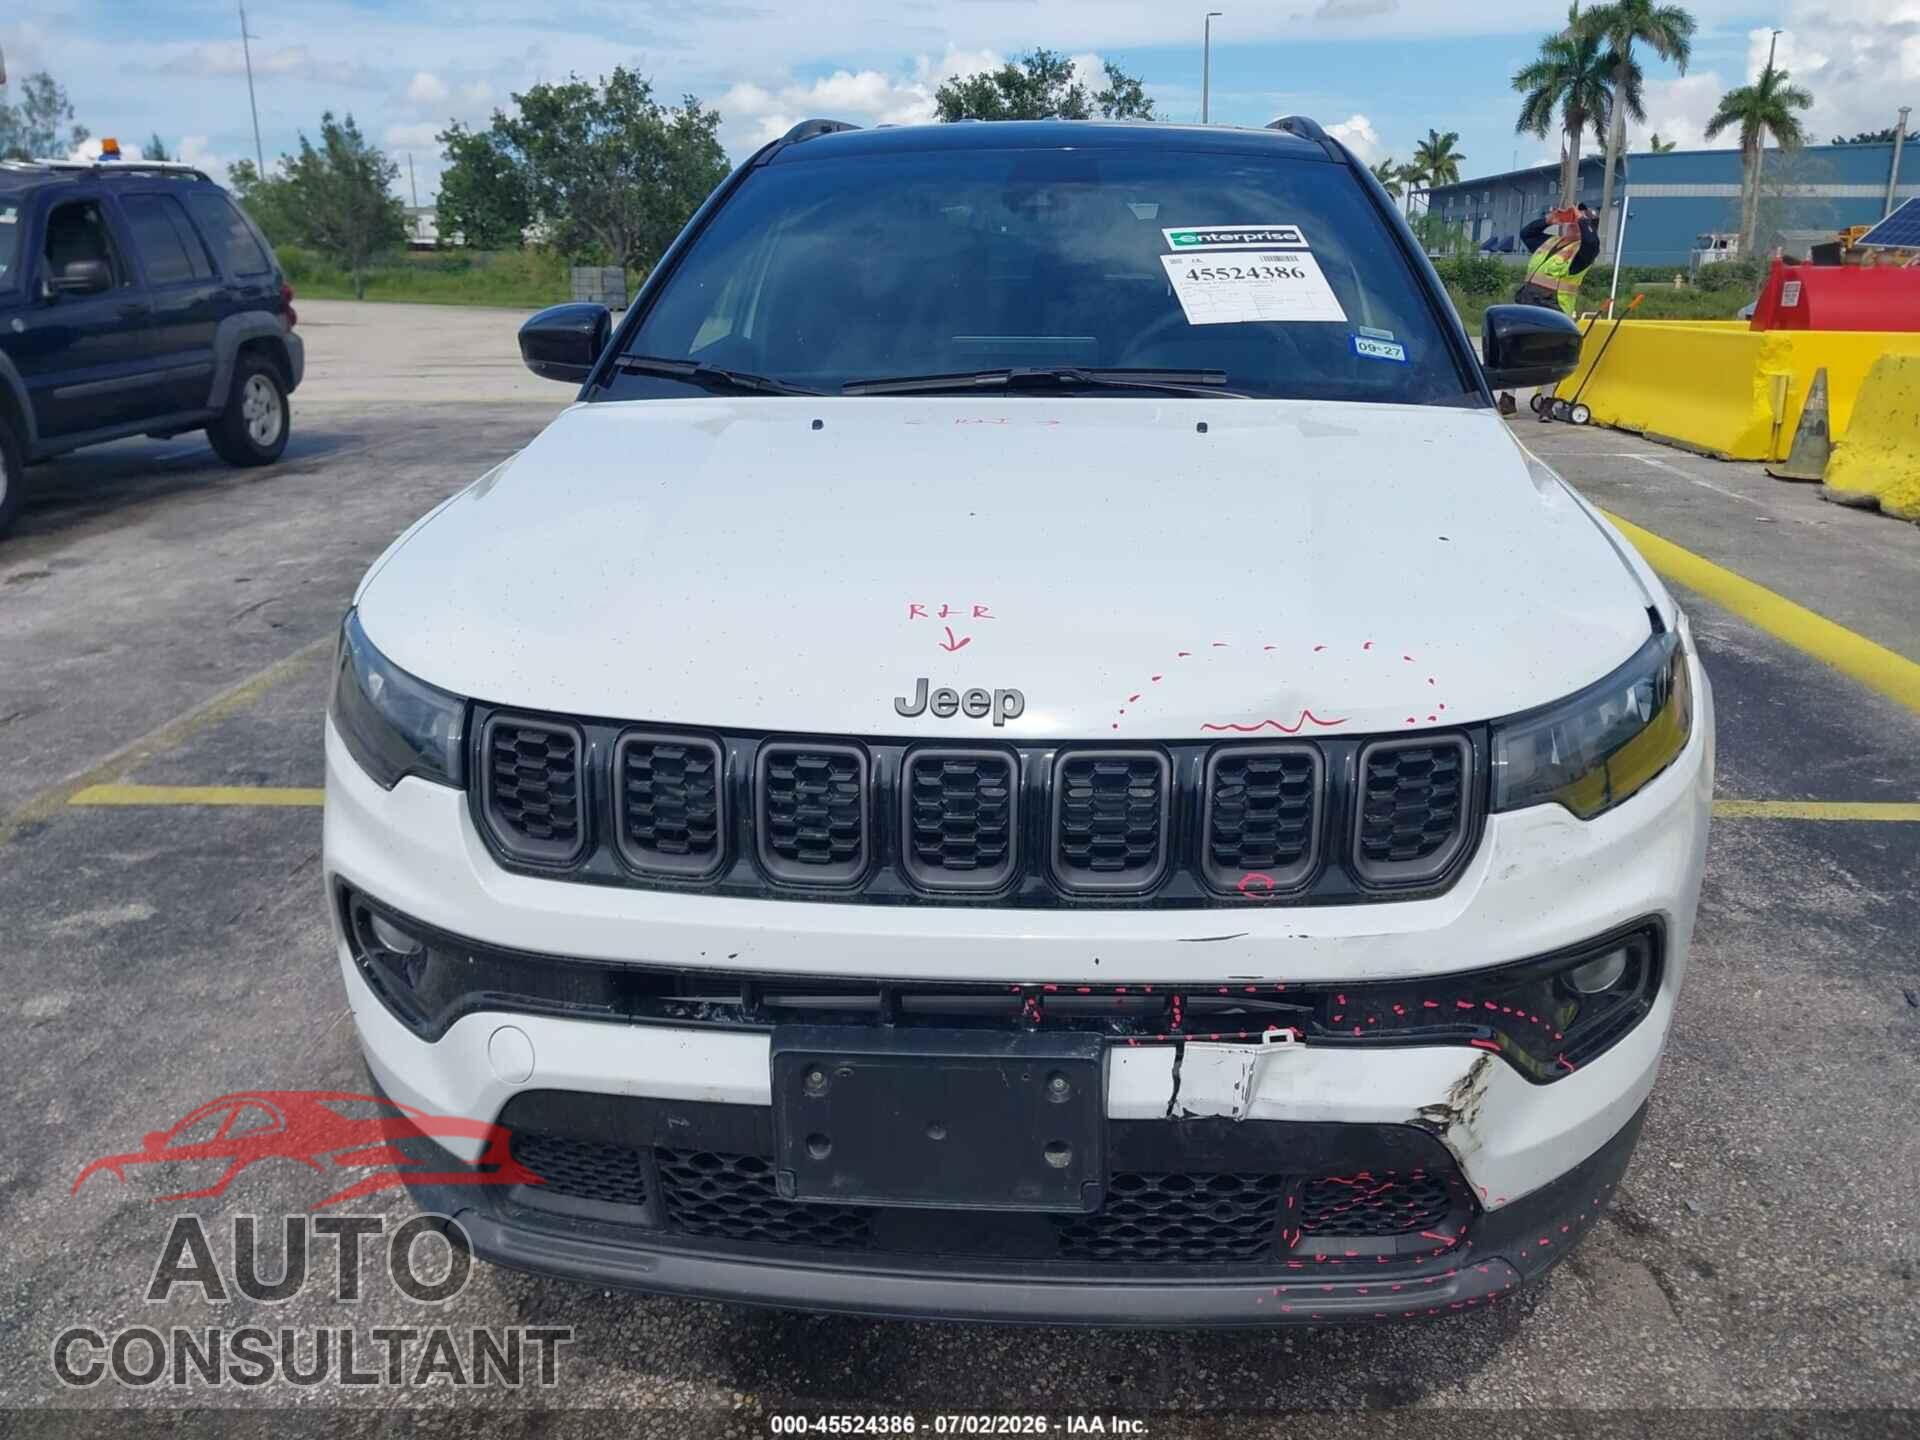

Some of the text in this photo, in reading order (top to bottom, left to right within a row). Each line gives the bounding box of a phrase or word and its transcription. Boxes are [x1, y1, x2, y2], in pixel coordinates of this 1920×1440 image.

[1173, 231, 1298, 242] enterprise
[1186, 266, 1305, 281] 45524386
[894, 678, 1025, 727] Jeep
